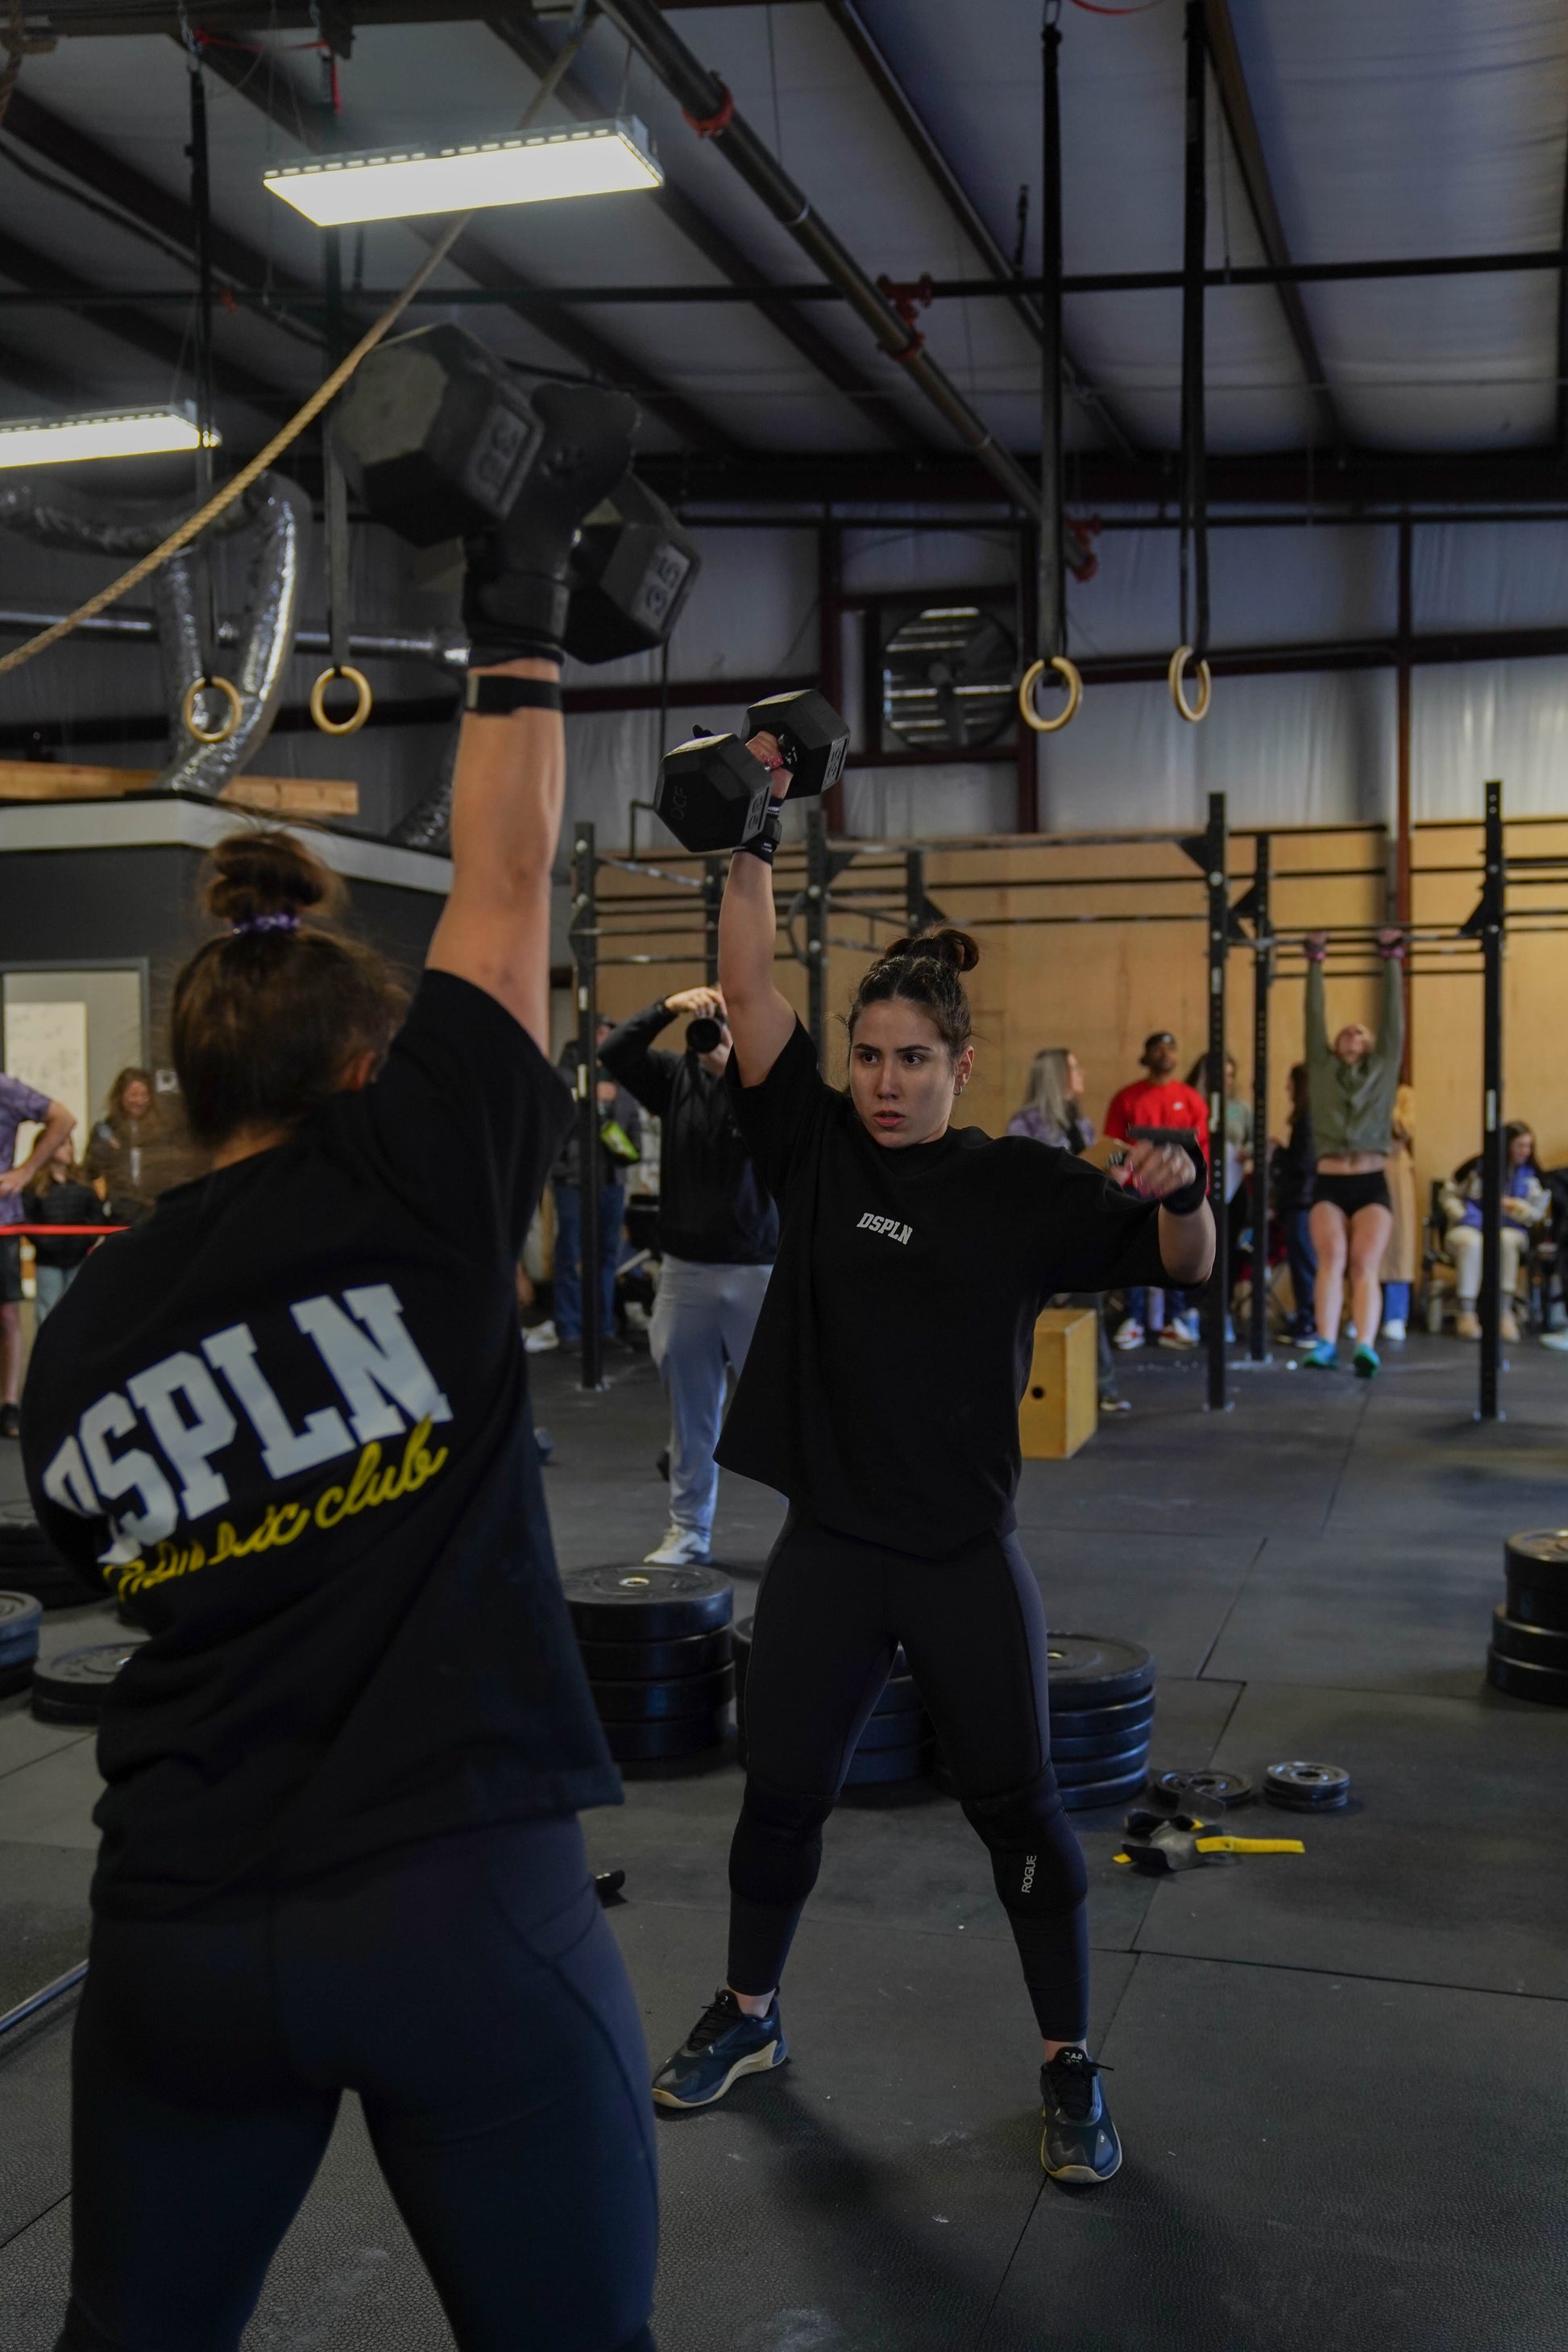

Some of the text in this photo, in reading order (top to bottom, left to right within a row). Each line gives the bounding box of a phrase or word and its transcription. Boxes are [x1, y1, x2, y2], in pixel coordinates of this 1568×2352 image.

[645, 556, 681, 616] 35
[856, 1212, 914, 1246] DSPLN
[313, 1414, 450, 1529] club
[1021, 1855, 1037, 1894] ROGUE
